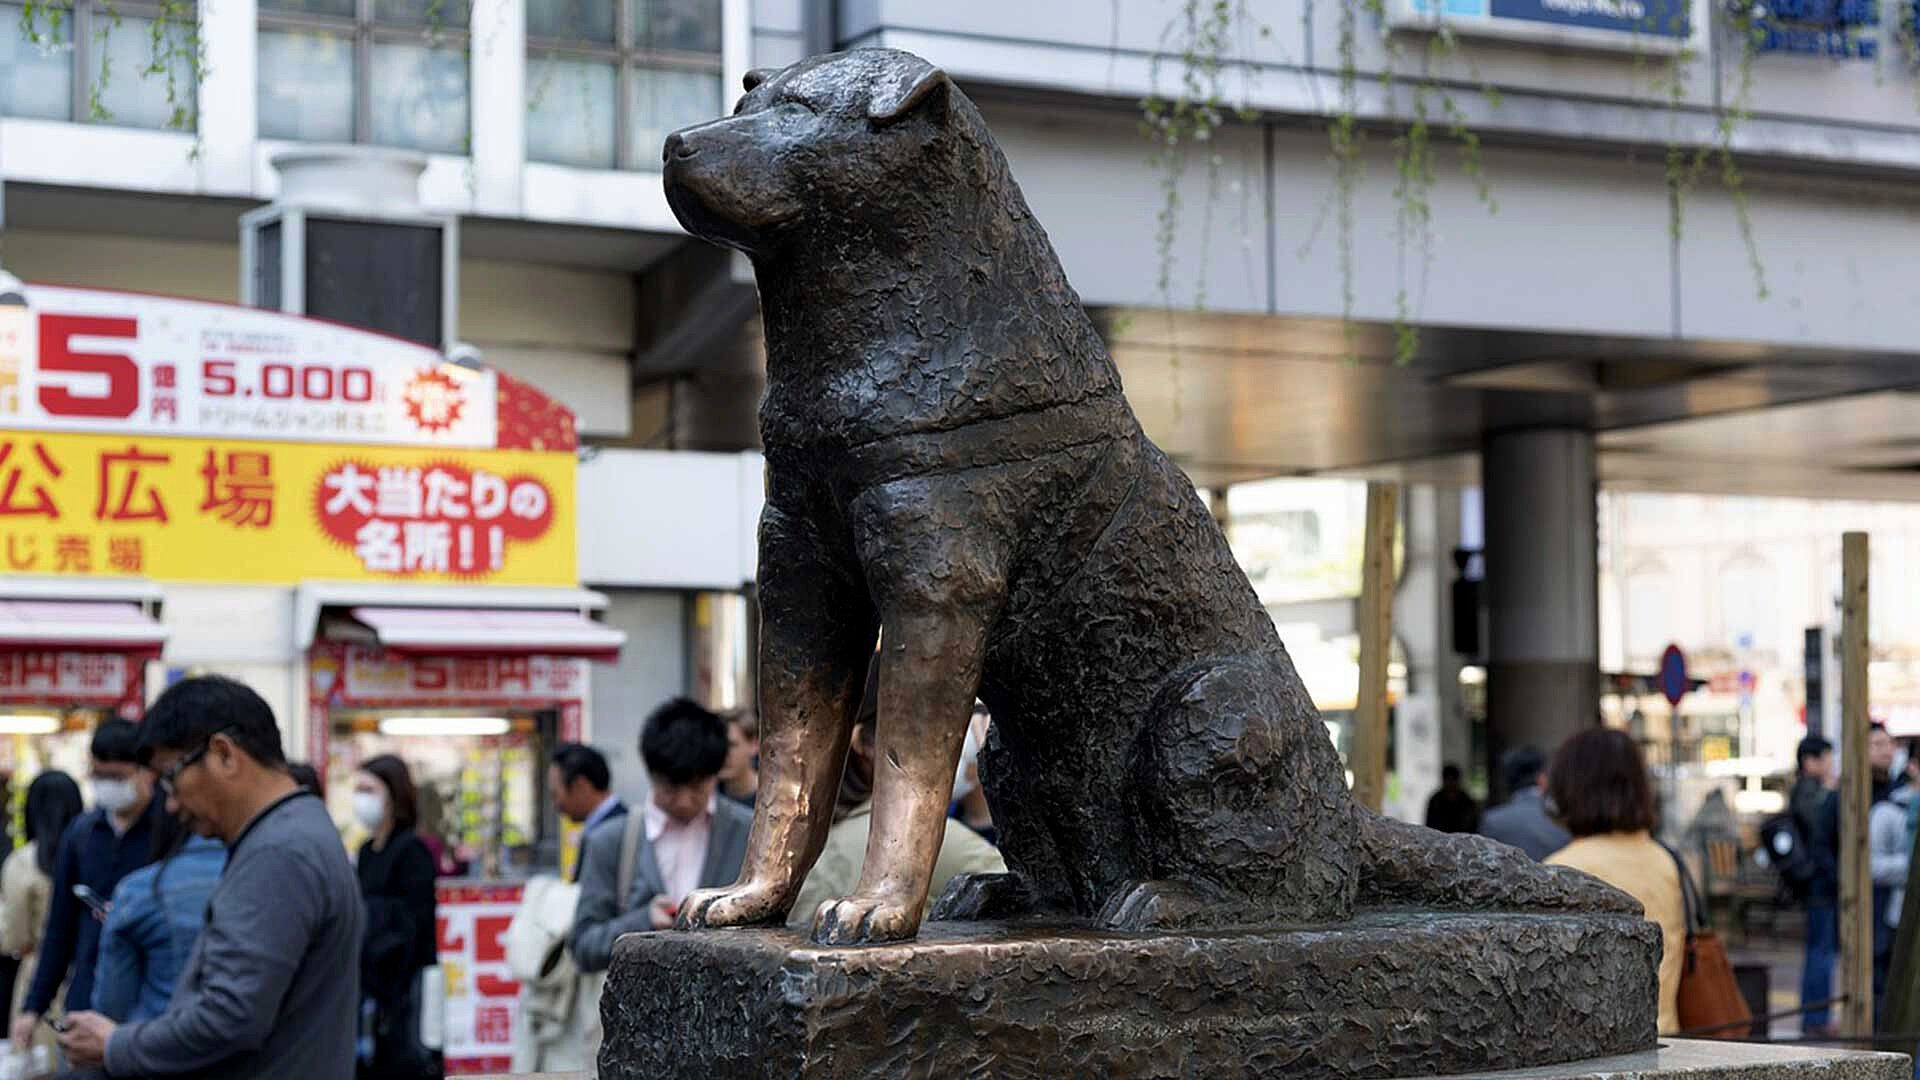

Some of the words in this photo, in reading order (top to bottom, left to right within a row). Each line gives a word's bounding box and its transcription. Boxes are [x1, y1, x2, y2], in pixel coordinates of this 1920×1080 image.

[0, 442, 274, 527] 公広場
[324, 464, 548, 520] 大当たりの
